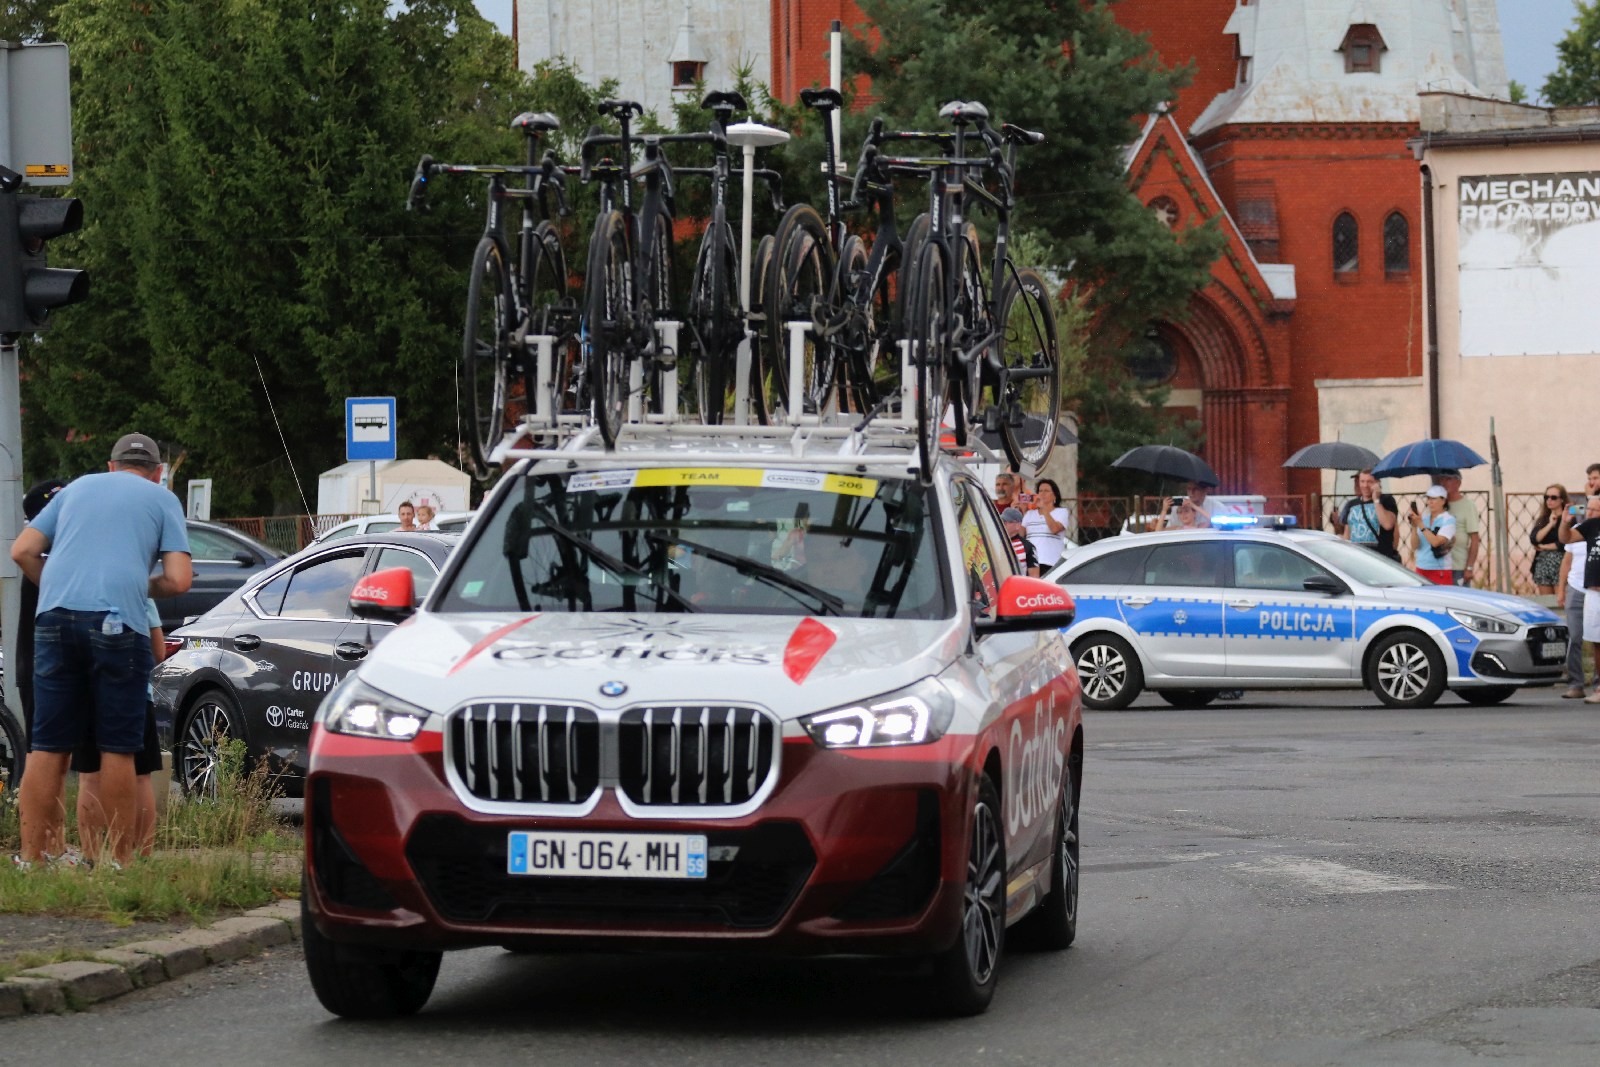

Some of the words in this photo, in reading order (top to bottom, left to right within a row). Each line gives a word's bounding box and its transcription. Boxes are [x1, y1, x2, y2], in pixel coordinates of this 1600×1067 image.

[681, 472, 720, 480] TEAM
[838, 480, 863, 490] 206
[352, 585, 389, 600] Cofidis
[1016, 594, 1065, 608] Cofidis
[1259, 610, 1336, 633] POLICJA
[292, 670, 340, 692] GRUPA
[286, 706, 305, 718] Carter
[1008, 693, 1065, 837] Cofidis
[532, 839, 680, 872] GN-064-MH
[687, 857, 704, 873] 59
